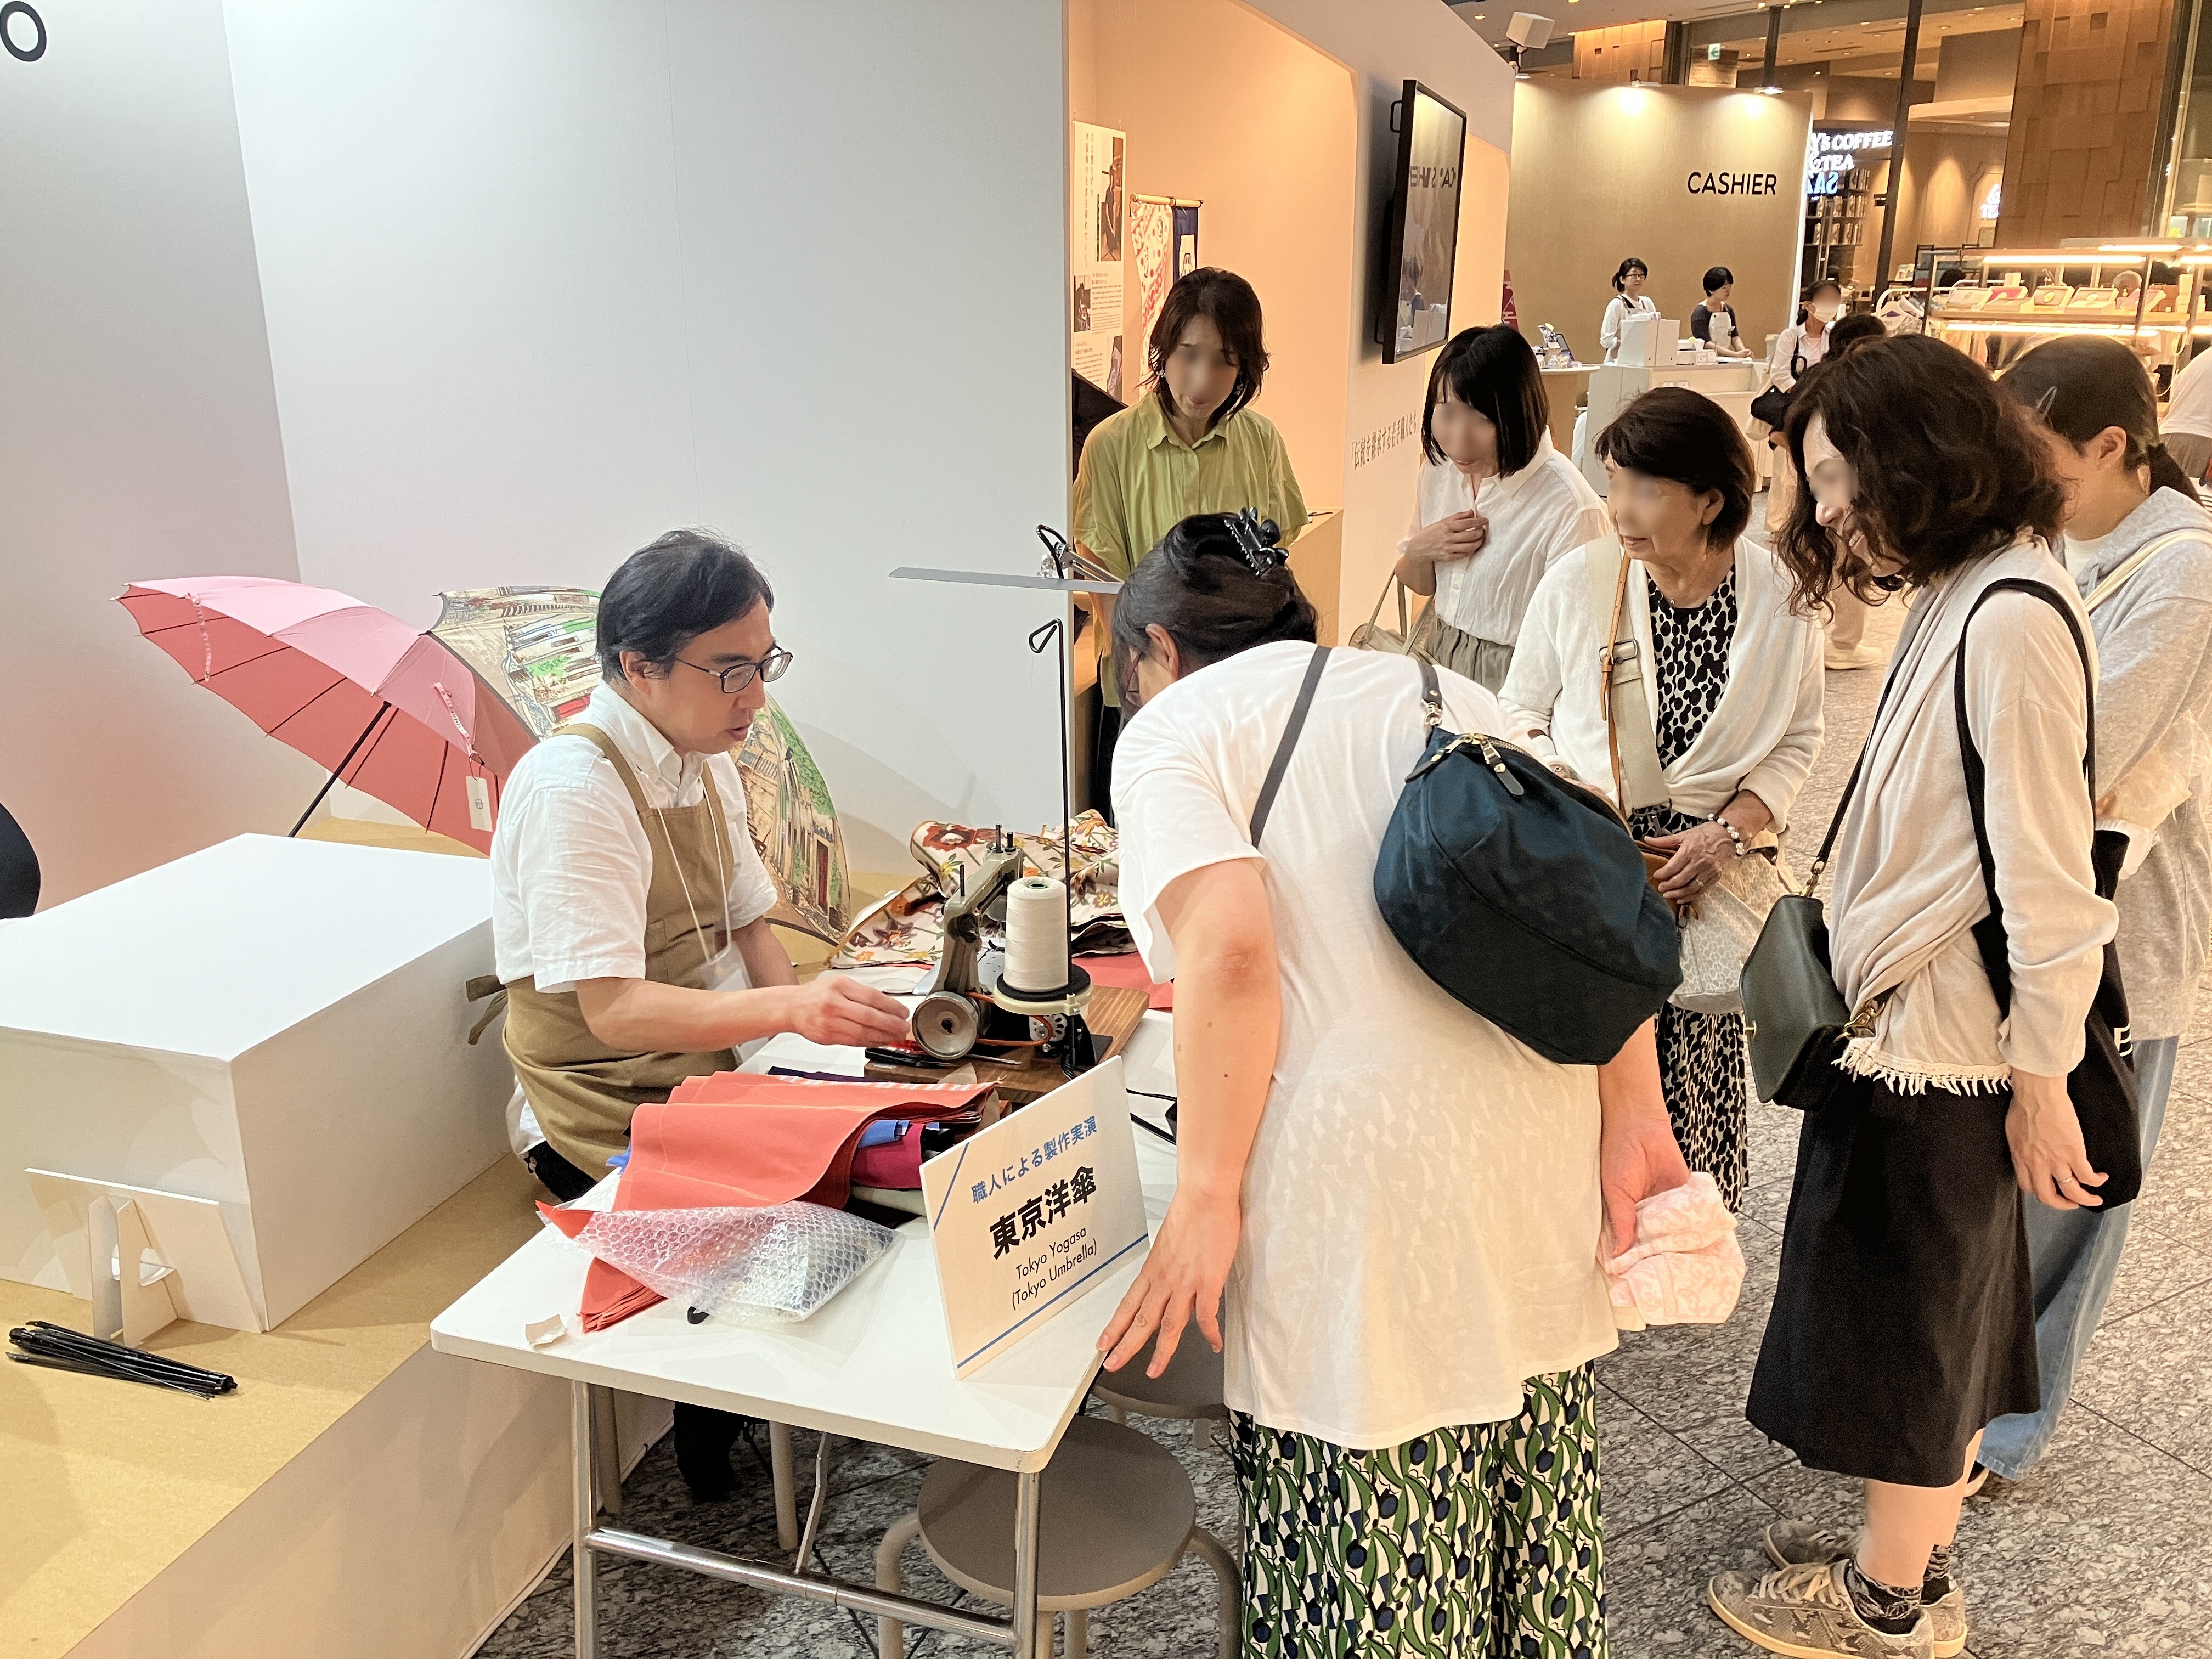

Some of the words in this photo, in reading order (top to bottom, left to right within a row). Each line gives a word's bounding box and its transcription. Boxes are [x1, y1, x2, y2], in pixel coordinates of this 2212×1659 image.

[0, 1, 47, 62] O
[1831, 131, 1893, 150] COFFEE
[1688, 172, 1777, 195] CASHIER
[971, 1115, 1097, 1204] 職人による製作実演
[989, 1166, 1097, 1260] 東京洋傘
[1012, 1280, 1047, 1310] (Tokyo
[1049, 1238, 1097, 1282] Umbrella)
[1015, 1252, 1047, 1280] Tokyo
[1049, 1227, 1087, 1260] Yogasa
